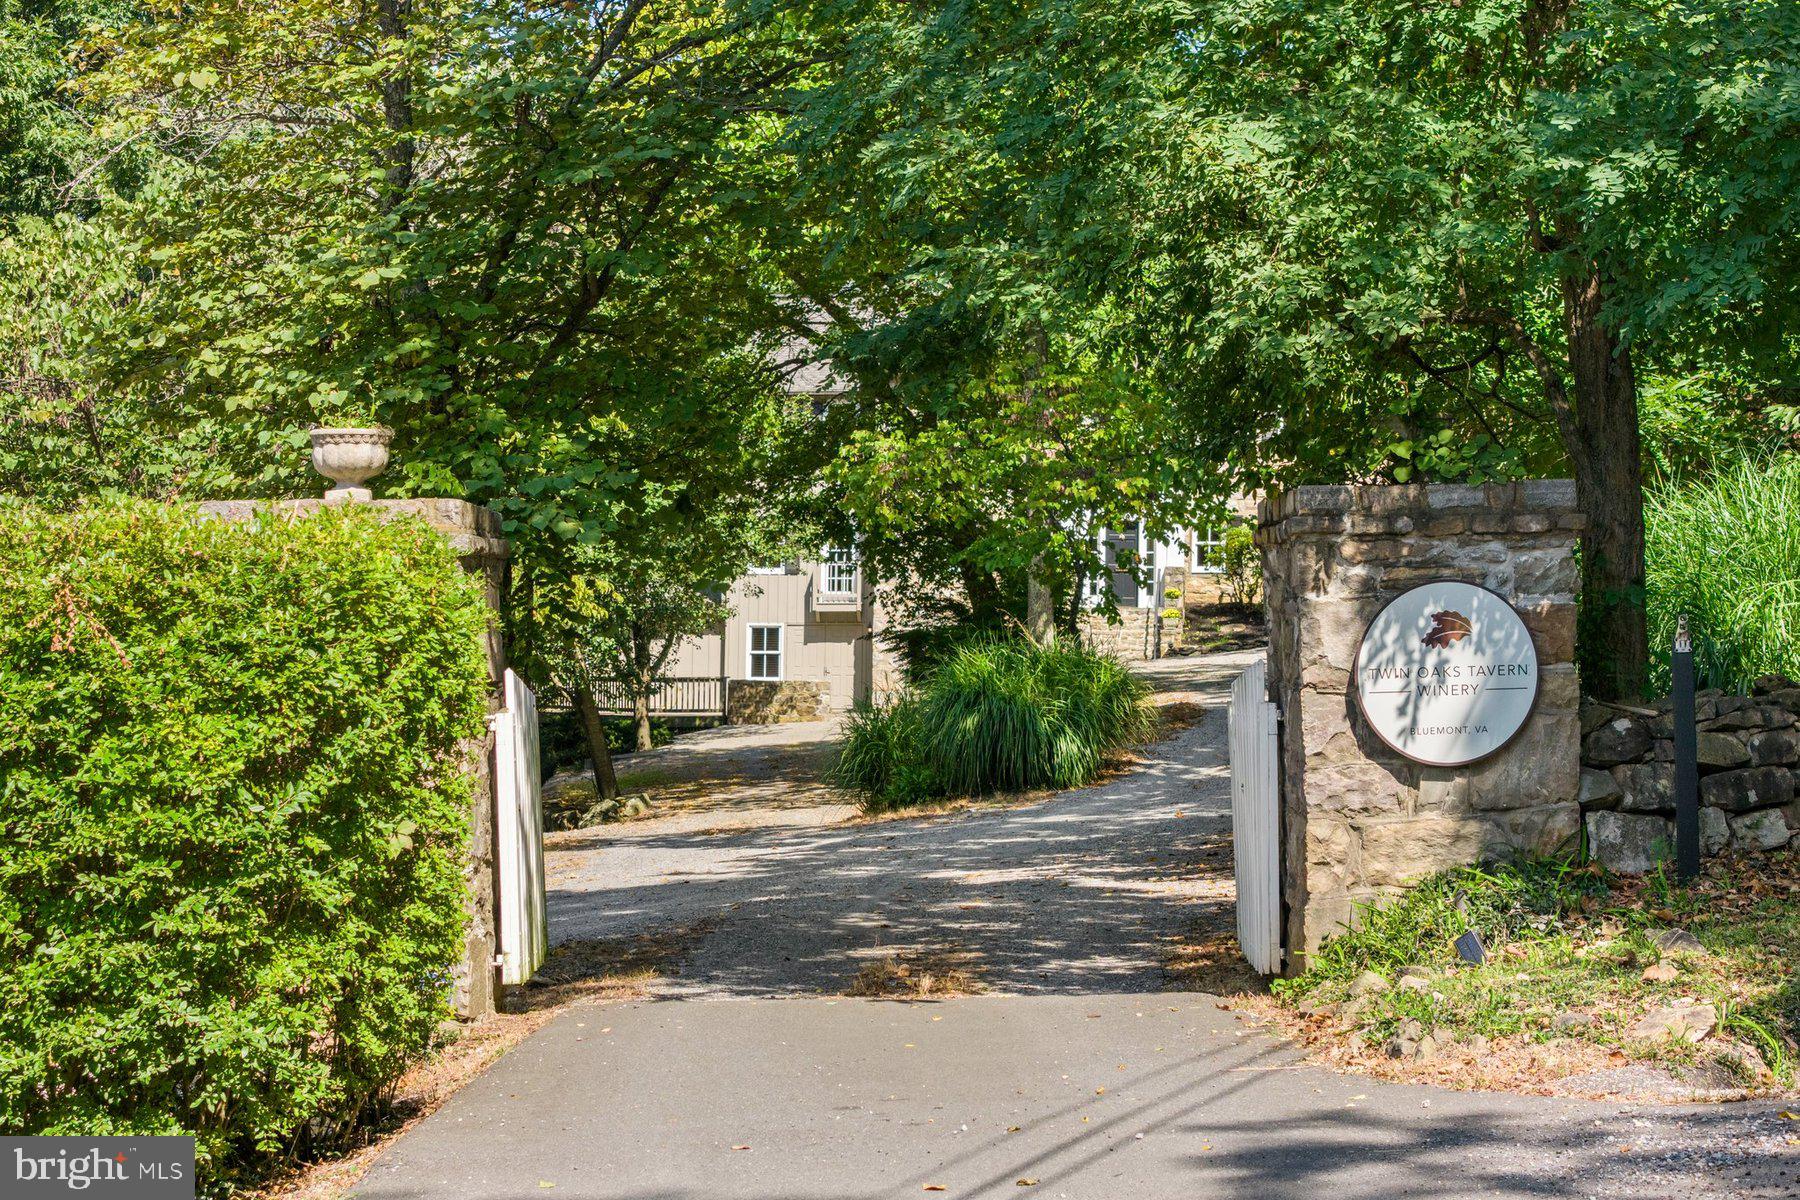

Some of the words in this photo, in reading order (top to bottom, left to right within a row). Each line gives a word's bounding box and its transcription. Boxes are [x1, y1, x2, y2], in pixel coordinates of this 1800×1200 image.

[1369, 667, 1410, 680] TWIN
[1417, 665, 1461, 679] OAKS
[1468, 664, 1528, 678] TAVERN
[1417, 684, 1479, 697] WINERY
[1410, 726, 1471, 736] BLUEMONT,
[1474, 725, 1488, 734] VA
